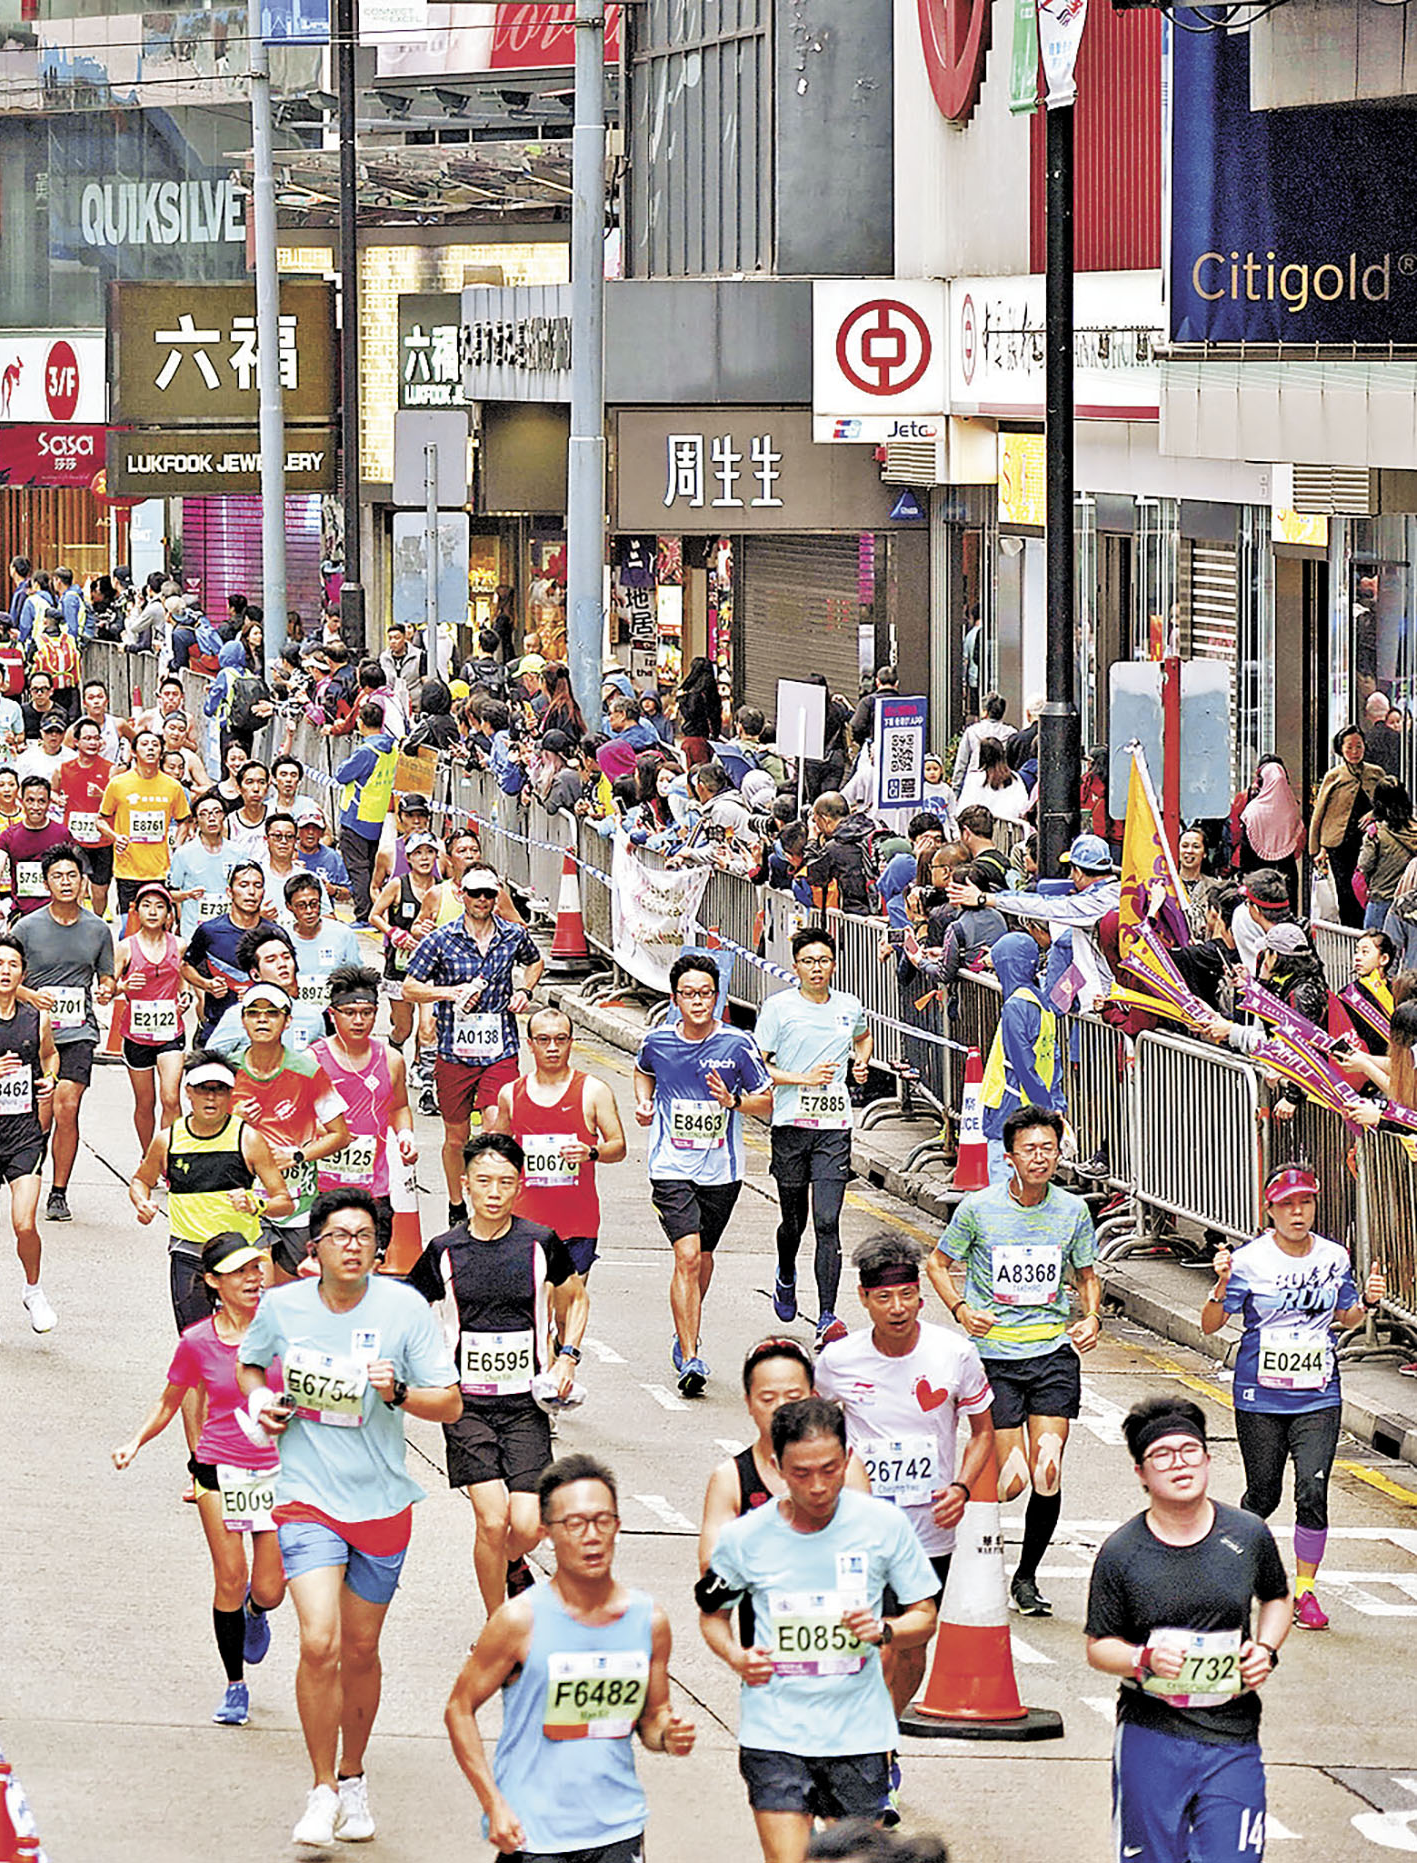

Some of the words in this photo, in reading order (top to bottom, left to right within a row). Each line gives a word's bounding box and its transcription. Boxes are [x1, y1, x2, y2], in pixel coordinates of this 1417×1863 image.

[83, 181, 246, 247] QUIKSILVE
[1191, 251, 1391, 313] Citigold
[154, 314, 298, 391] 六福
[404, 325, 459, 383] 六福
[47, 366, 76, 398] 3/F
[127, 453, 213, 473] LUKFOOK
[215, 452, 325, 474] JEWEERY
[664, 433, 783, 507] 周生生
[70, 820, 96, 832] E372
[133, 820, 163, 832] E8761
[200, 902, 233, 916] E737
[134, 1011, 176, 1027] E2122
[457, 1029, 500, 1045] A0138
[800, 1096, 846, 1112] E7885
[674, 1113, 723, 1131] E8463
[997, 1263, 1057, 1284] A8368
[1277, 1287, 1336, 1311] RUN
[467, 1350, 530, 1372] E6595
[1263, 1351, 1323, 1372] E0244
[287, 1367, 359, 1405] E6754
[865, 1456, 932, 1482] 26742
[224, 1491, 274, 1513] E009
[1182, 1654, 1236, 1682] 732
[554, 1679, 642, 1708] F6482
[1238, 1807, 1265, 1855] 14
